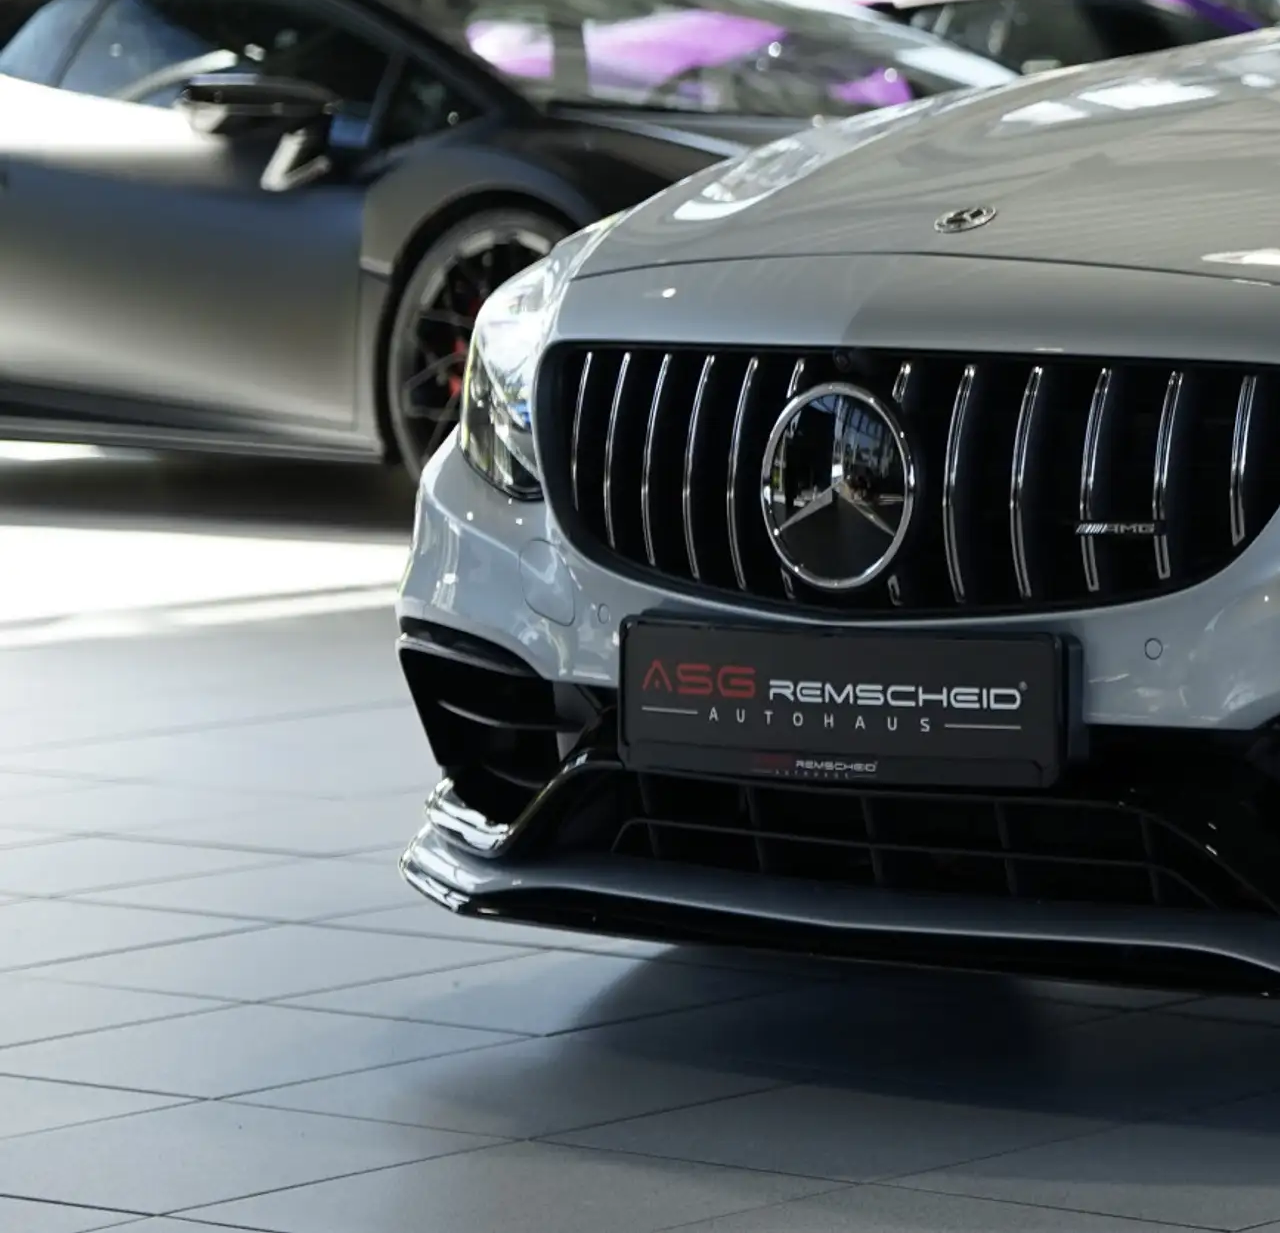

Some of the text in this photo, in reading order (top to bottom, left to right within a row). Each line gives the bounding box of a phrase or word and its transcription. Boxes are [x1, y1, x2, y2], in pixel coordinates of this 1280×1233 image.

[642, 659, 1022, 711] ASG REMSCHEID
[708, 706, 931, 733] AUTOHAUS
